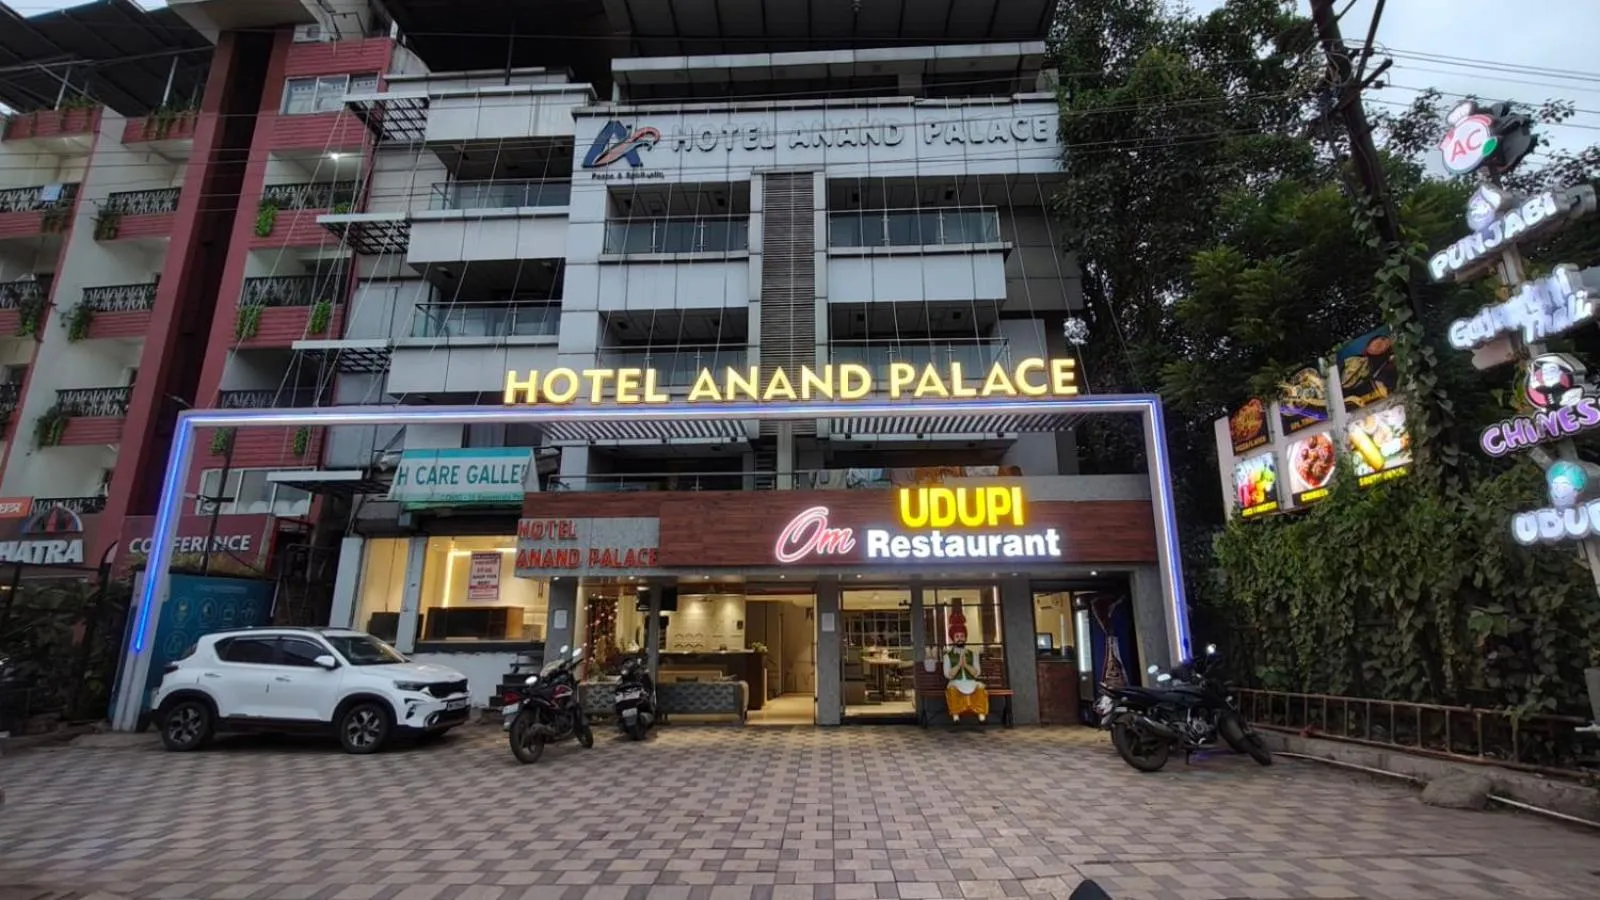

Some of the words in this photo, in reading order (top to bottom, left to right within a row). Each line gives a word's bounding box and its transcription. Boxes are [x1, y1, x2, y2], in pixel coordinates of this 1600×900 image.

[671, 121, 776, 153] HOTEL
[790, 117, 905, 149] ANAND
[924, 115, 1049, 145] PALACE
[1450, 128, 1482, 162] AC
[1429, 191, 1557, 279] PUNJABI
[504, 368, 669, 405] HOTEL
[688, 363, 872, 402] ANAND
[891, 358, 1078, 399] PALACE
[415, 464, 460, 485] CARE
[899, 486, 1025, 528] UDUPI
[129, 534, 252, 553] COFERNCE
[518, 519, 578, 541] HOTEL
[775, 506, 856, 563] Om
[867, 528, 1062, 558] Restaurant
[516, 548, 580, 569] ANAND
[588, 547, 659, 569] PALACE
